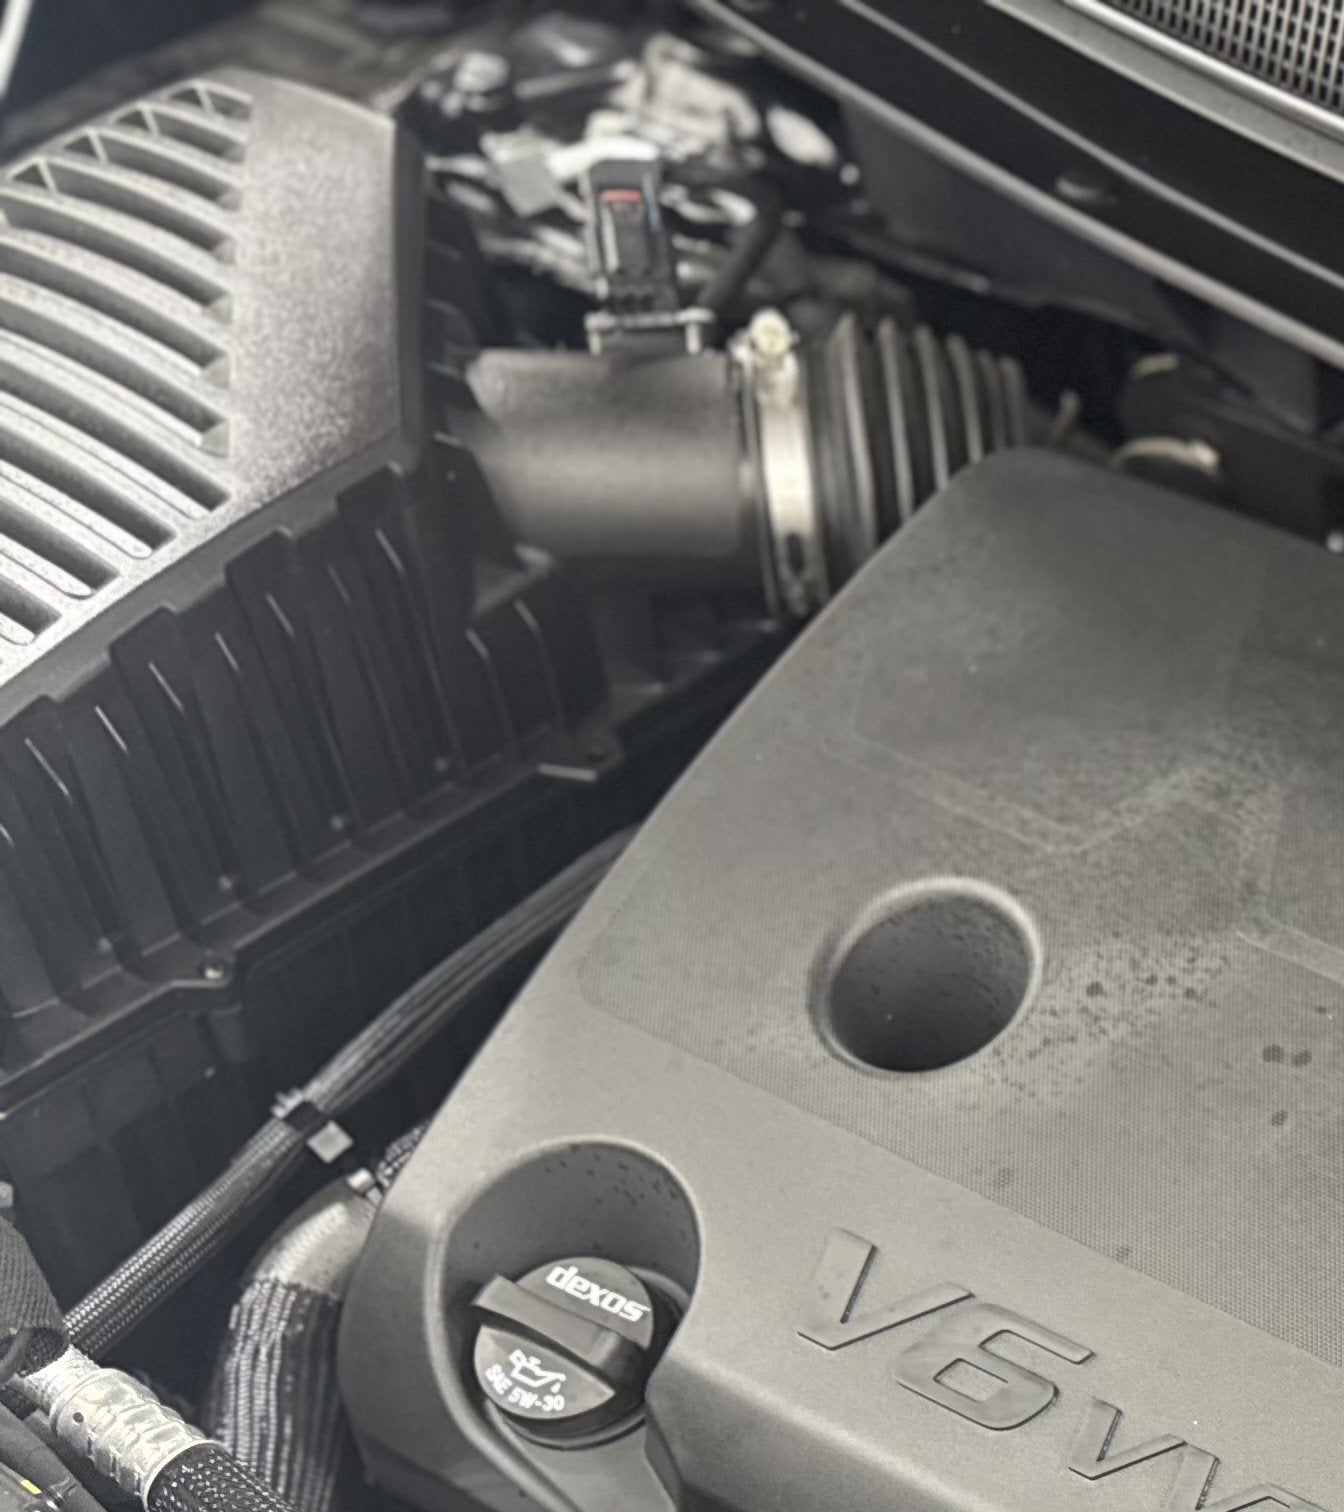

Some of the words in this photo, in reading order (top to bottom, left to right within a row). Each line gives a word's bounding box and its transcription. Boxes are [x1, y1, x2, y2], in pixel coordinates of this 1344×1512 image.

[546, 1266, 652, 1322] dexos
[797, 1226, 1096, 1431] V6
[507, 1386, 565, 1412] 5W-30
